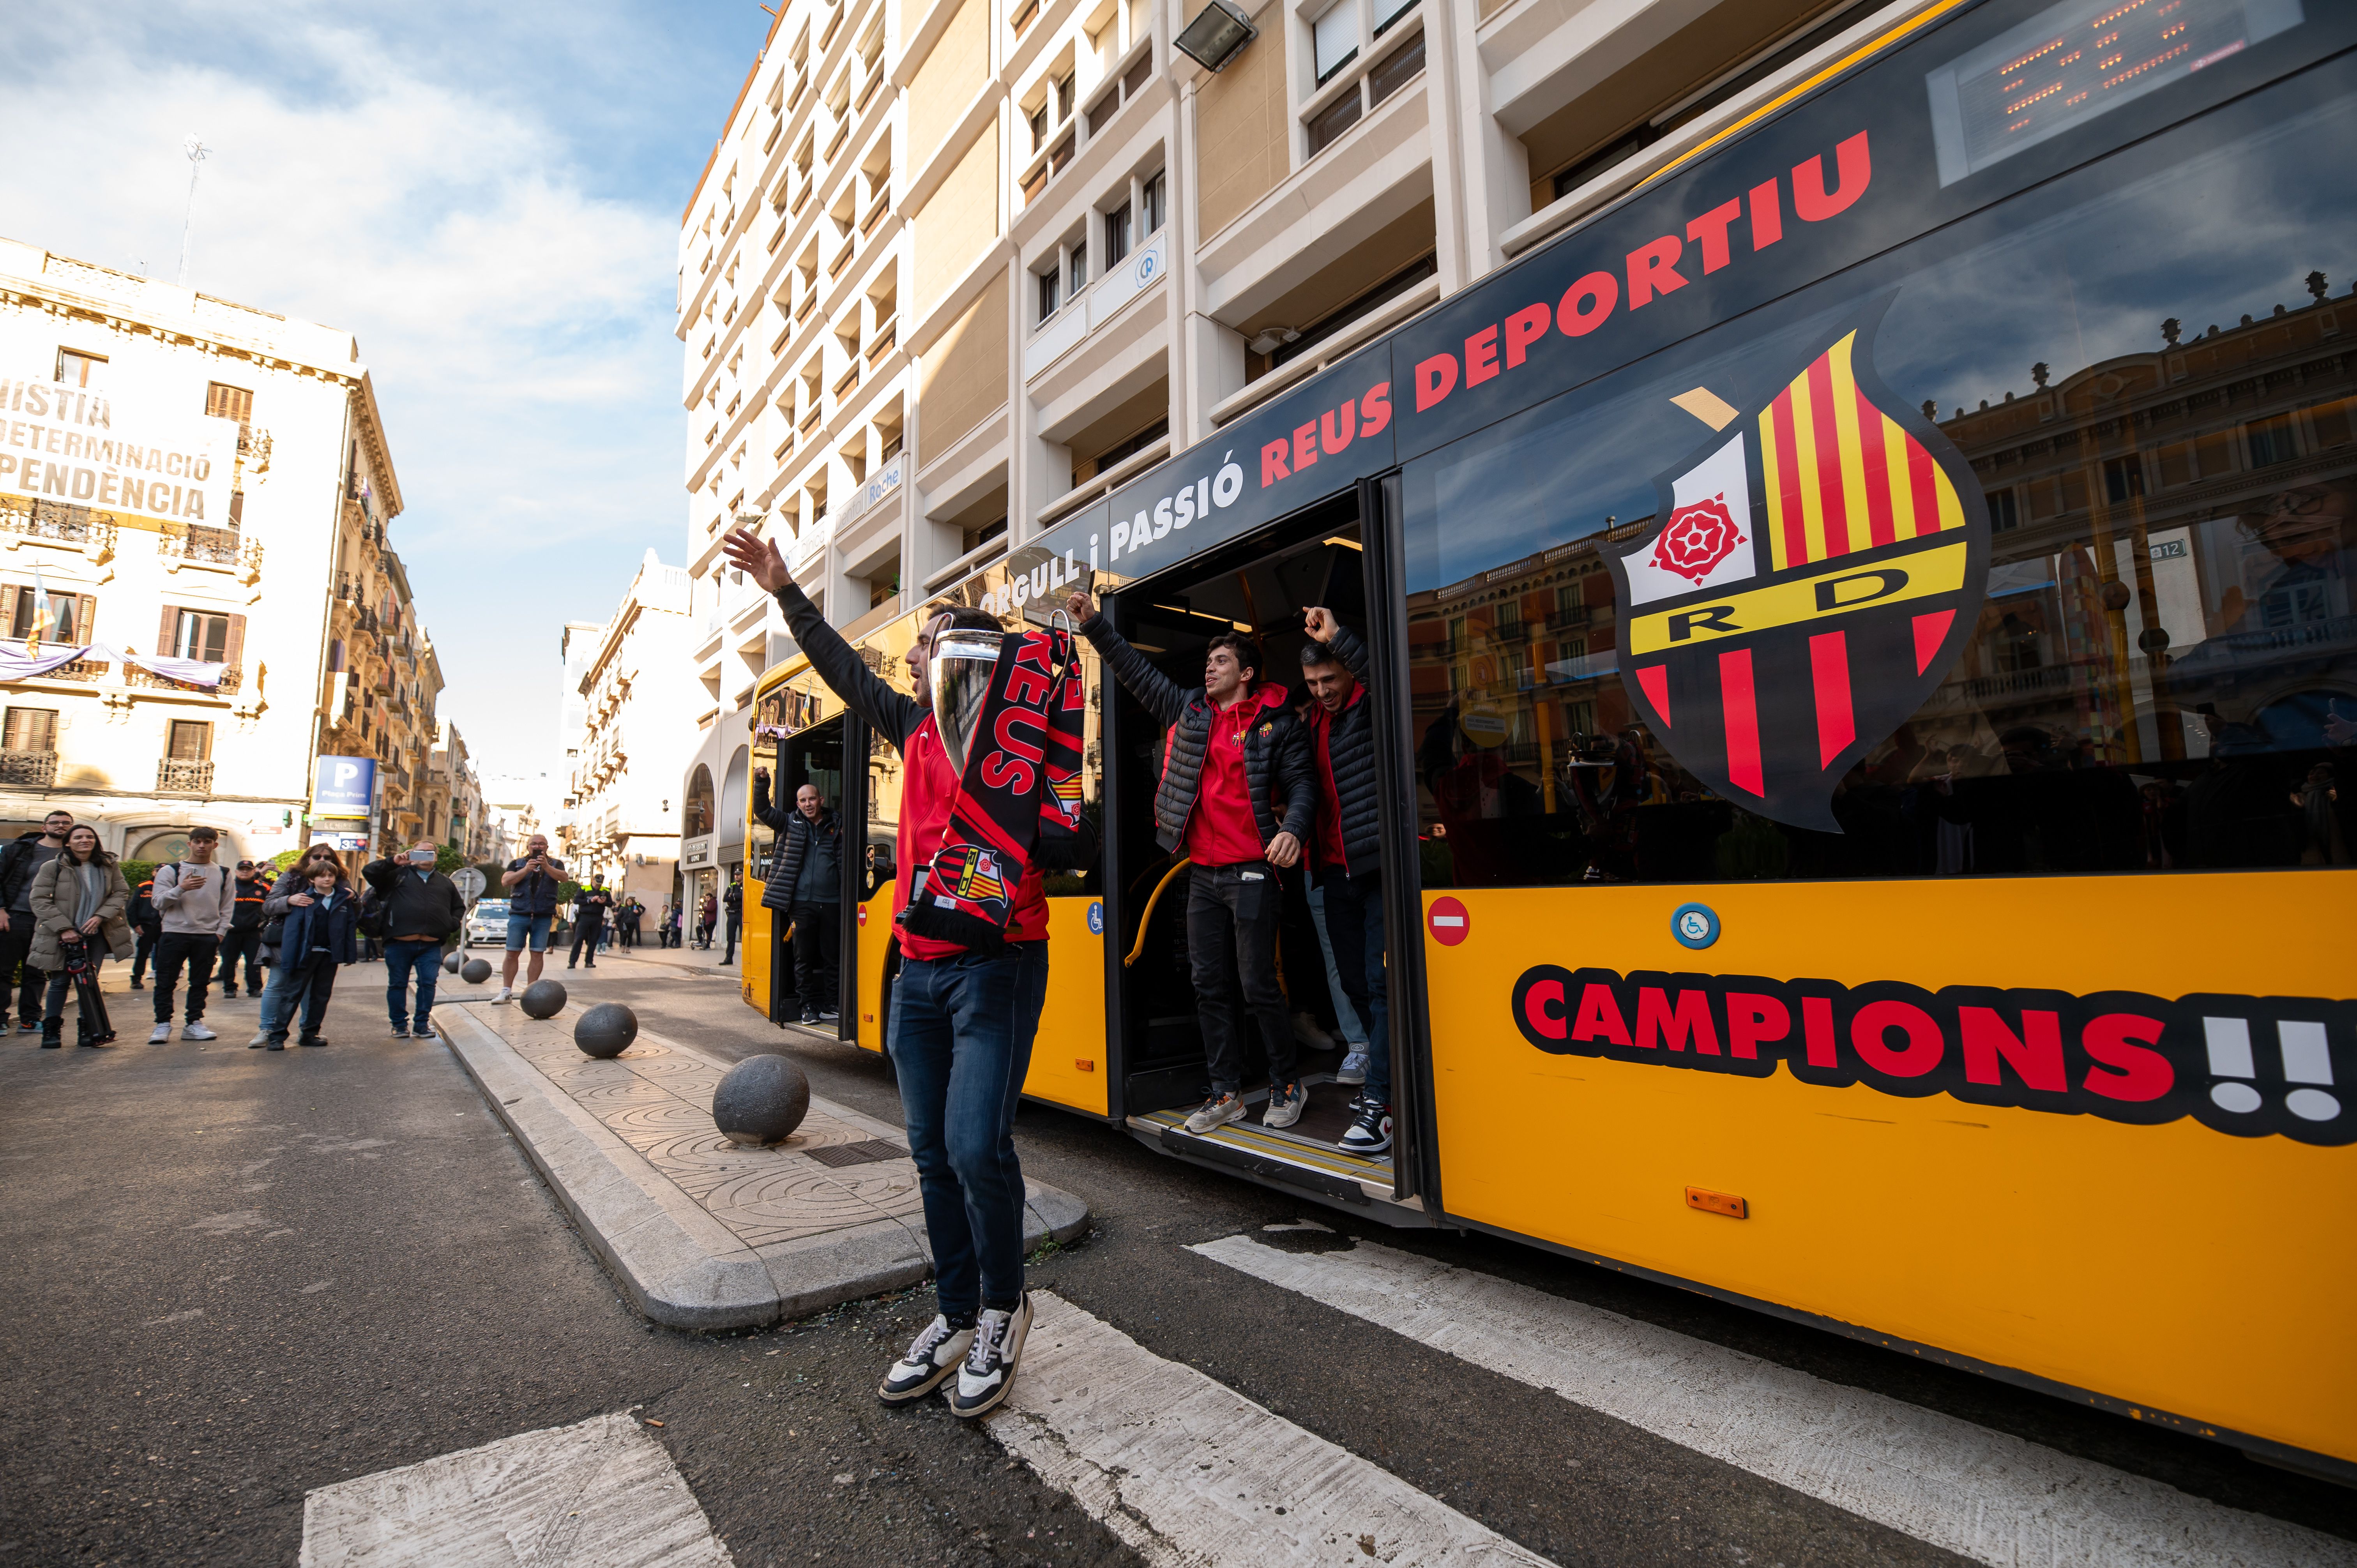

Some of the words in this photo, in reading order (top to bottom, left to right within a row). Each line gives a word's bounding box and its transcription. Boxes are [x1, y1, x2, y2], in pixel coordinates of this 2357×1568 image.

[979, 548, 1080, 618] ORGULL
[1090, 533, 1098, 572] i
[1110, 449, 1243, 562] PASSIÓ
[1261, 382, 1392, 489] REUS
[1415, 130, 1871, 413] DEPORTIU
[836, 493, 864, 530] Dental
[869, 470, 898, 504] Roche
[2163, 543, 2179, 556] 12
[1668, 605, 1744, 642] R
[1814, 569, 1909, 611] D
[981, 630, 1053, 795] REUS
[334, 762, 359, 788] P
